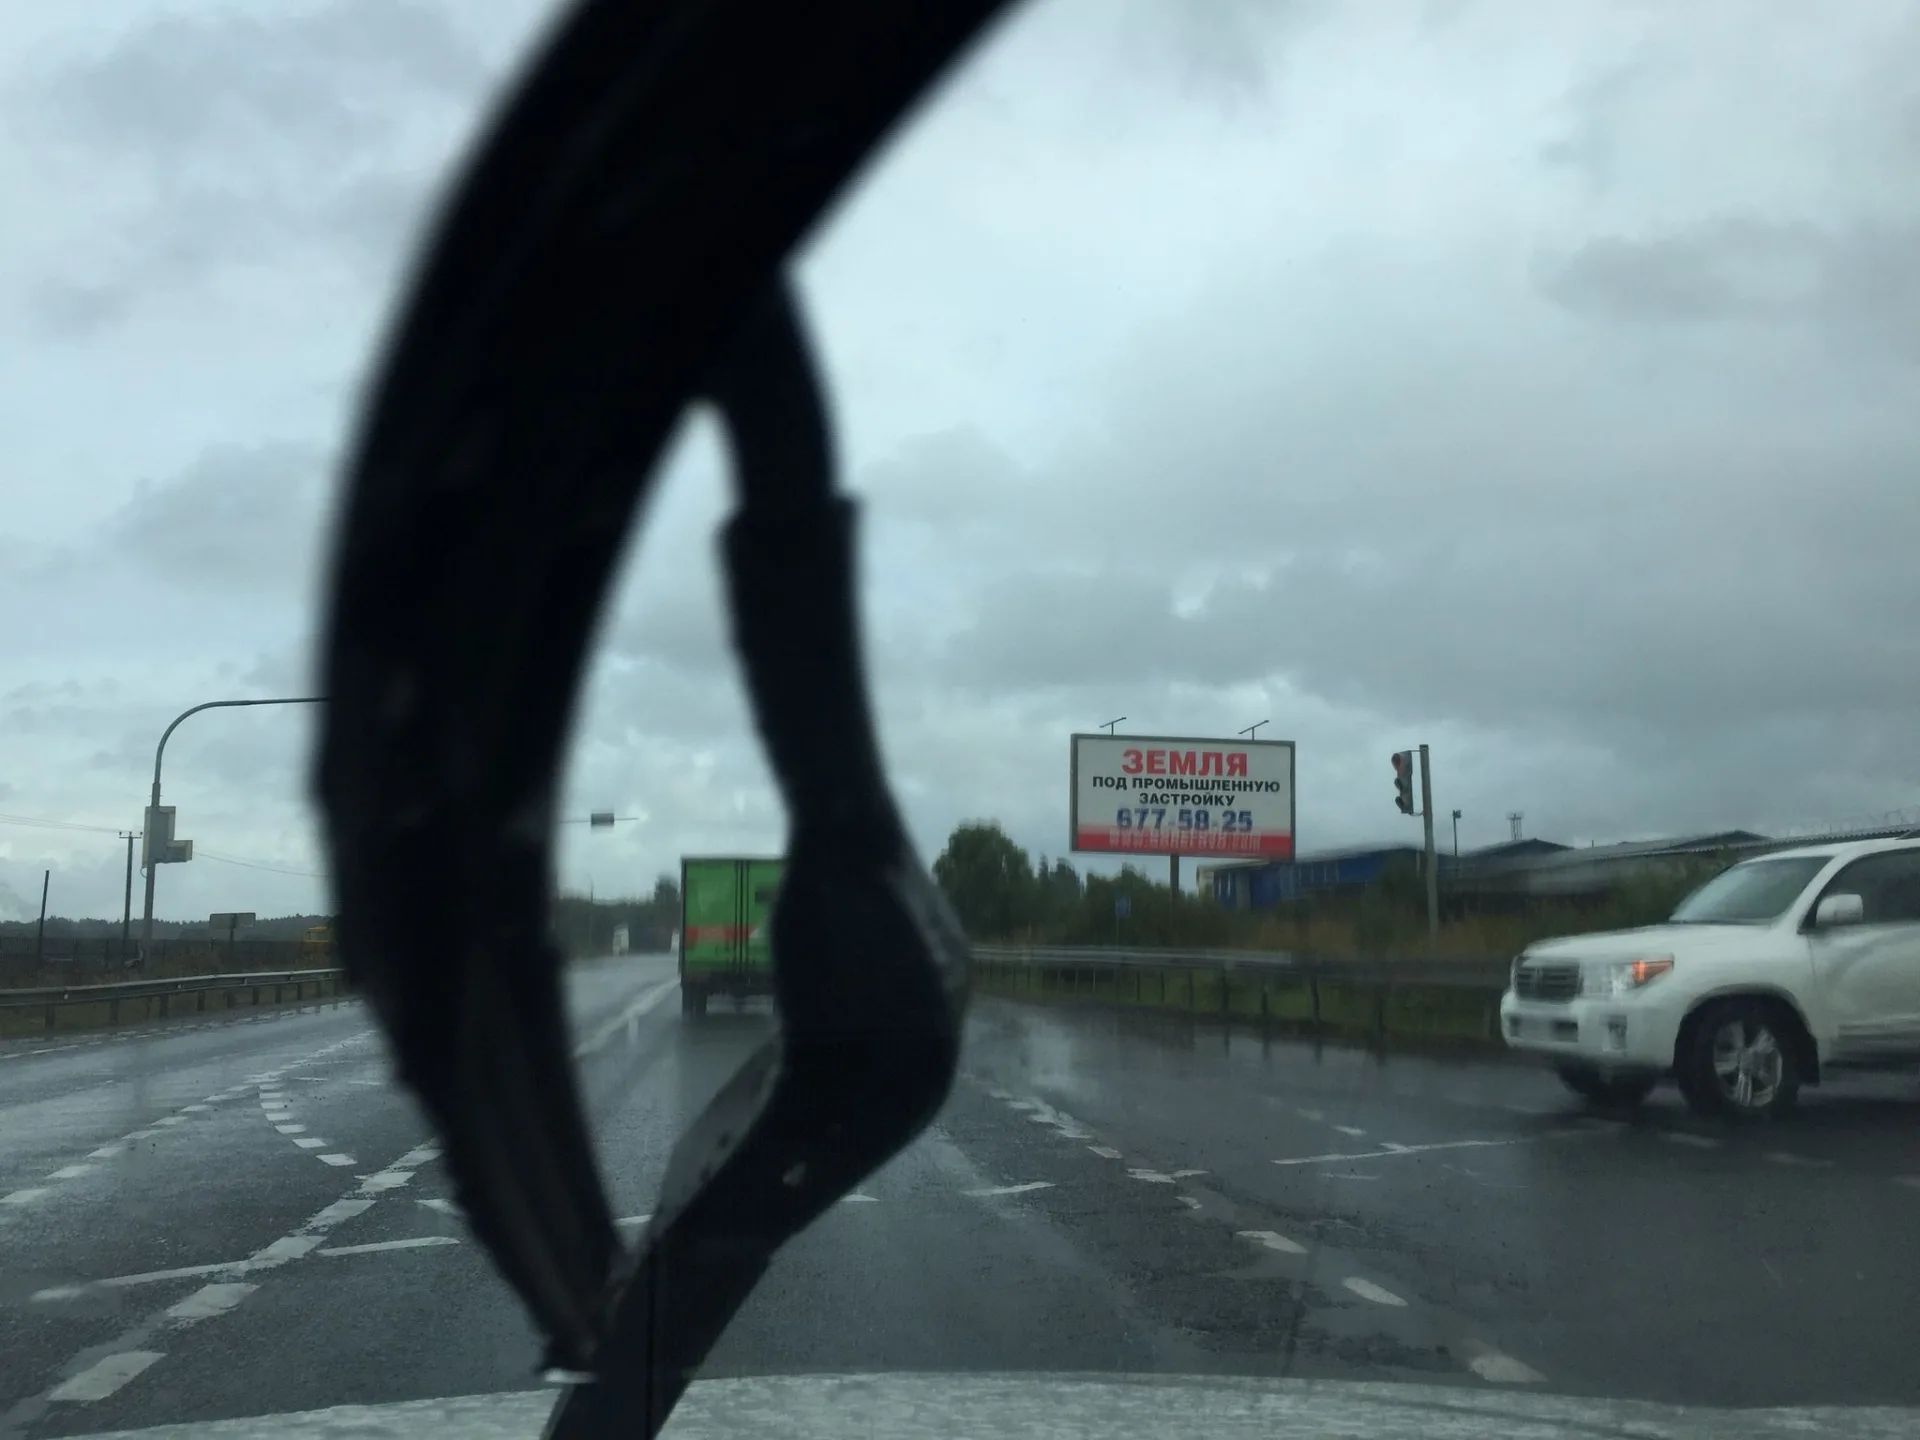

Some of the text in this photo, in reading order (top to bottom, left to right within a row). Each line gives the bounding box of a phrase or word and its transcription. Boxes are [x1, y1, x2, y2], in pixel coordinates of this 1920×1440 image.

[1121, 748, 1248, 777] ЗЕМЛЯ
[1092, 776, 1281, 793] ПОД ПРОМЫШЛЕННУЮ
[1139, 792, 1236, 807] ЗАСТРОЙКУ
